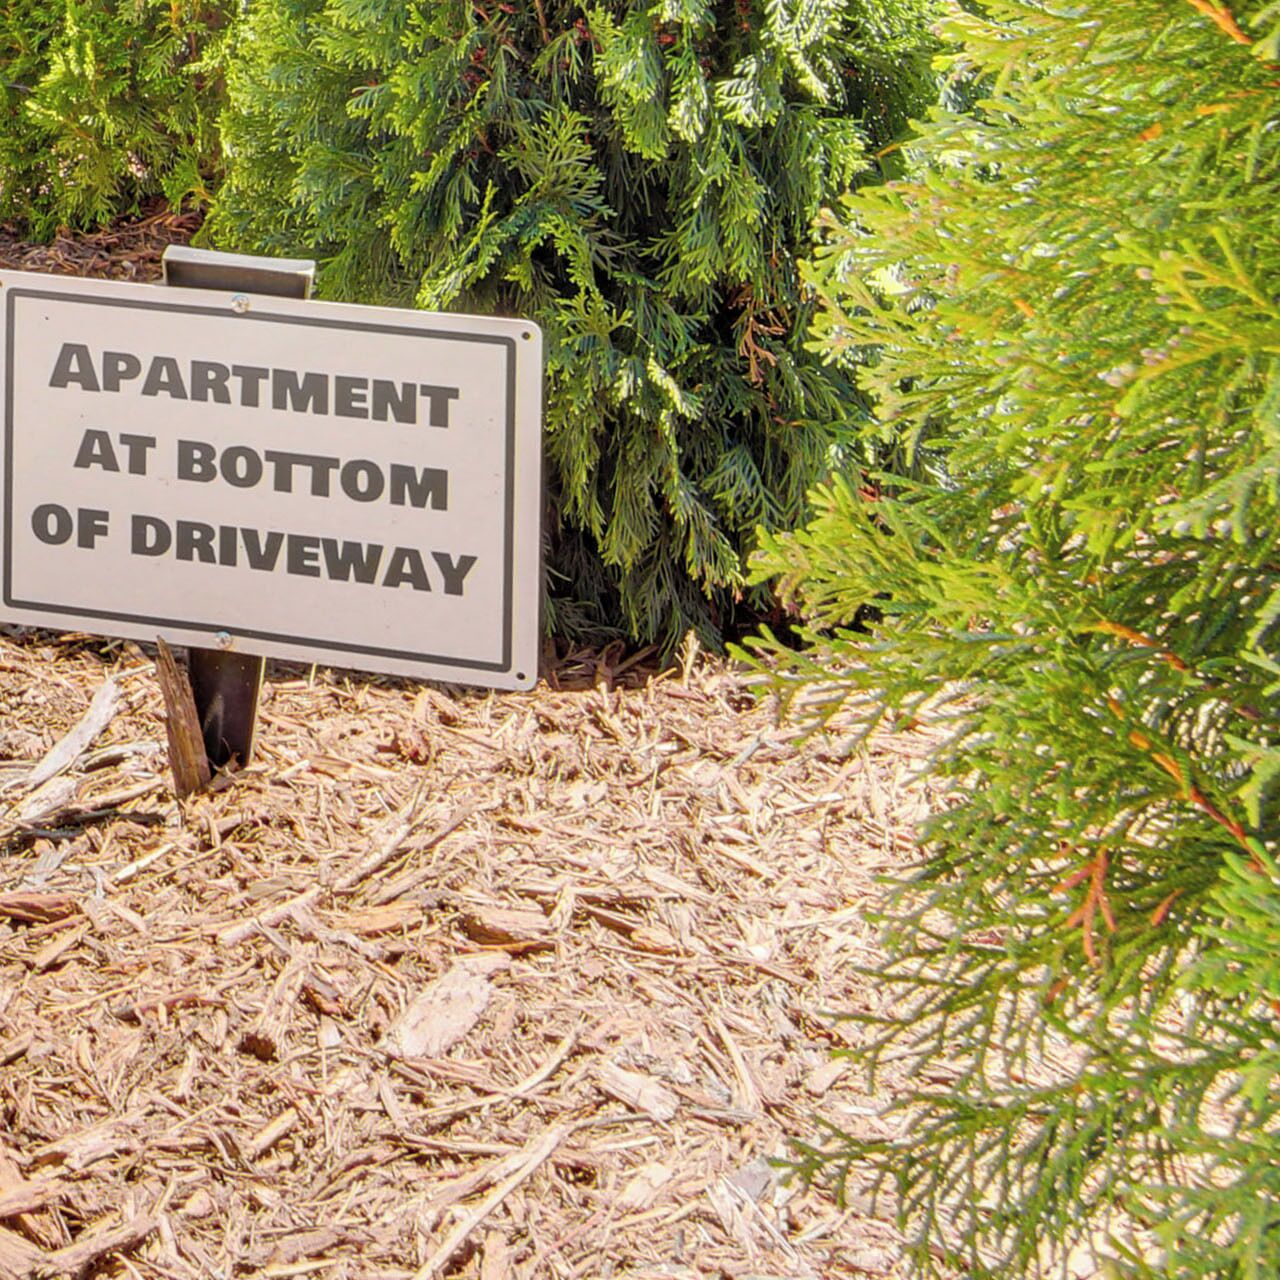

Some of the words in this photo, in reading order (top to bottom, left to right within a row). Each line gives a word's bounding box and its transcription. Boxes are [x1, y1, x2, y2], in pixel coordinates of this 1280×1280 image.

[48, 342, 460, 428] APARTMENT
[73, 429, 156, 475] AT
[177, 439, 449, 511] BOTTOM
[31, 503, 109, 549] OF
[130, 514, 478, 596] DRIVEWAY
